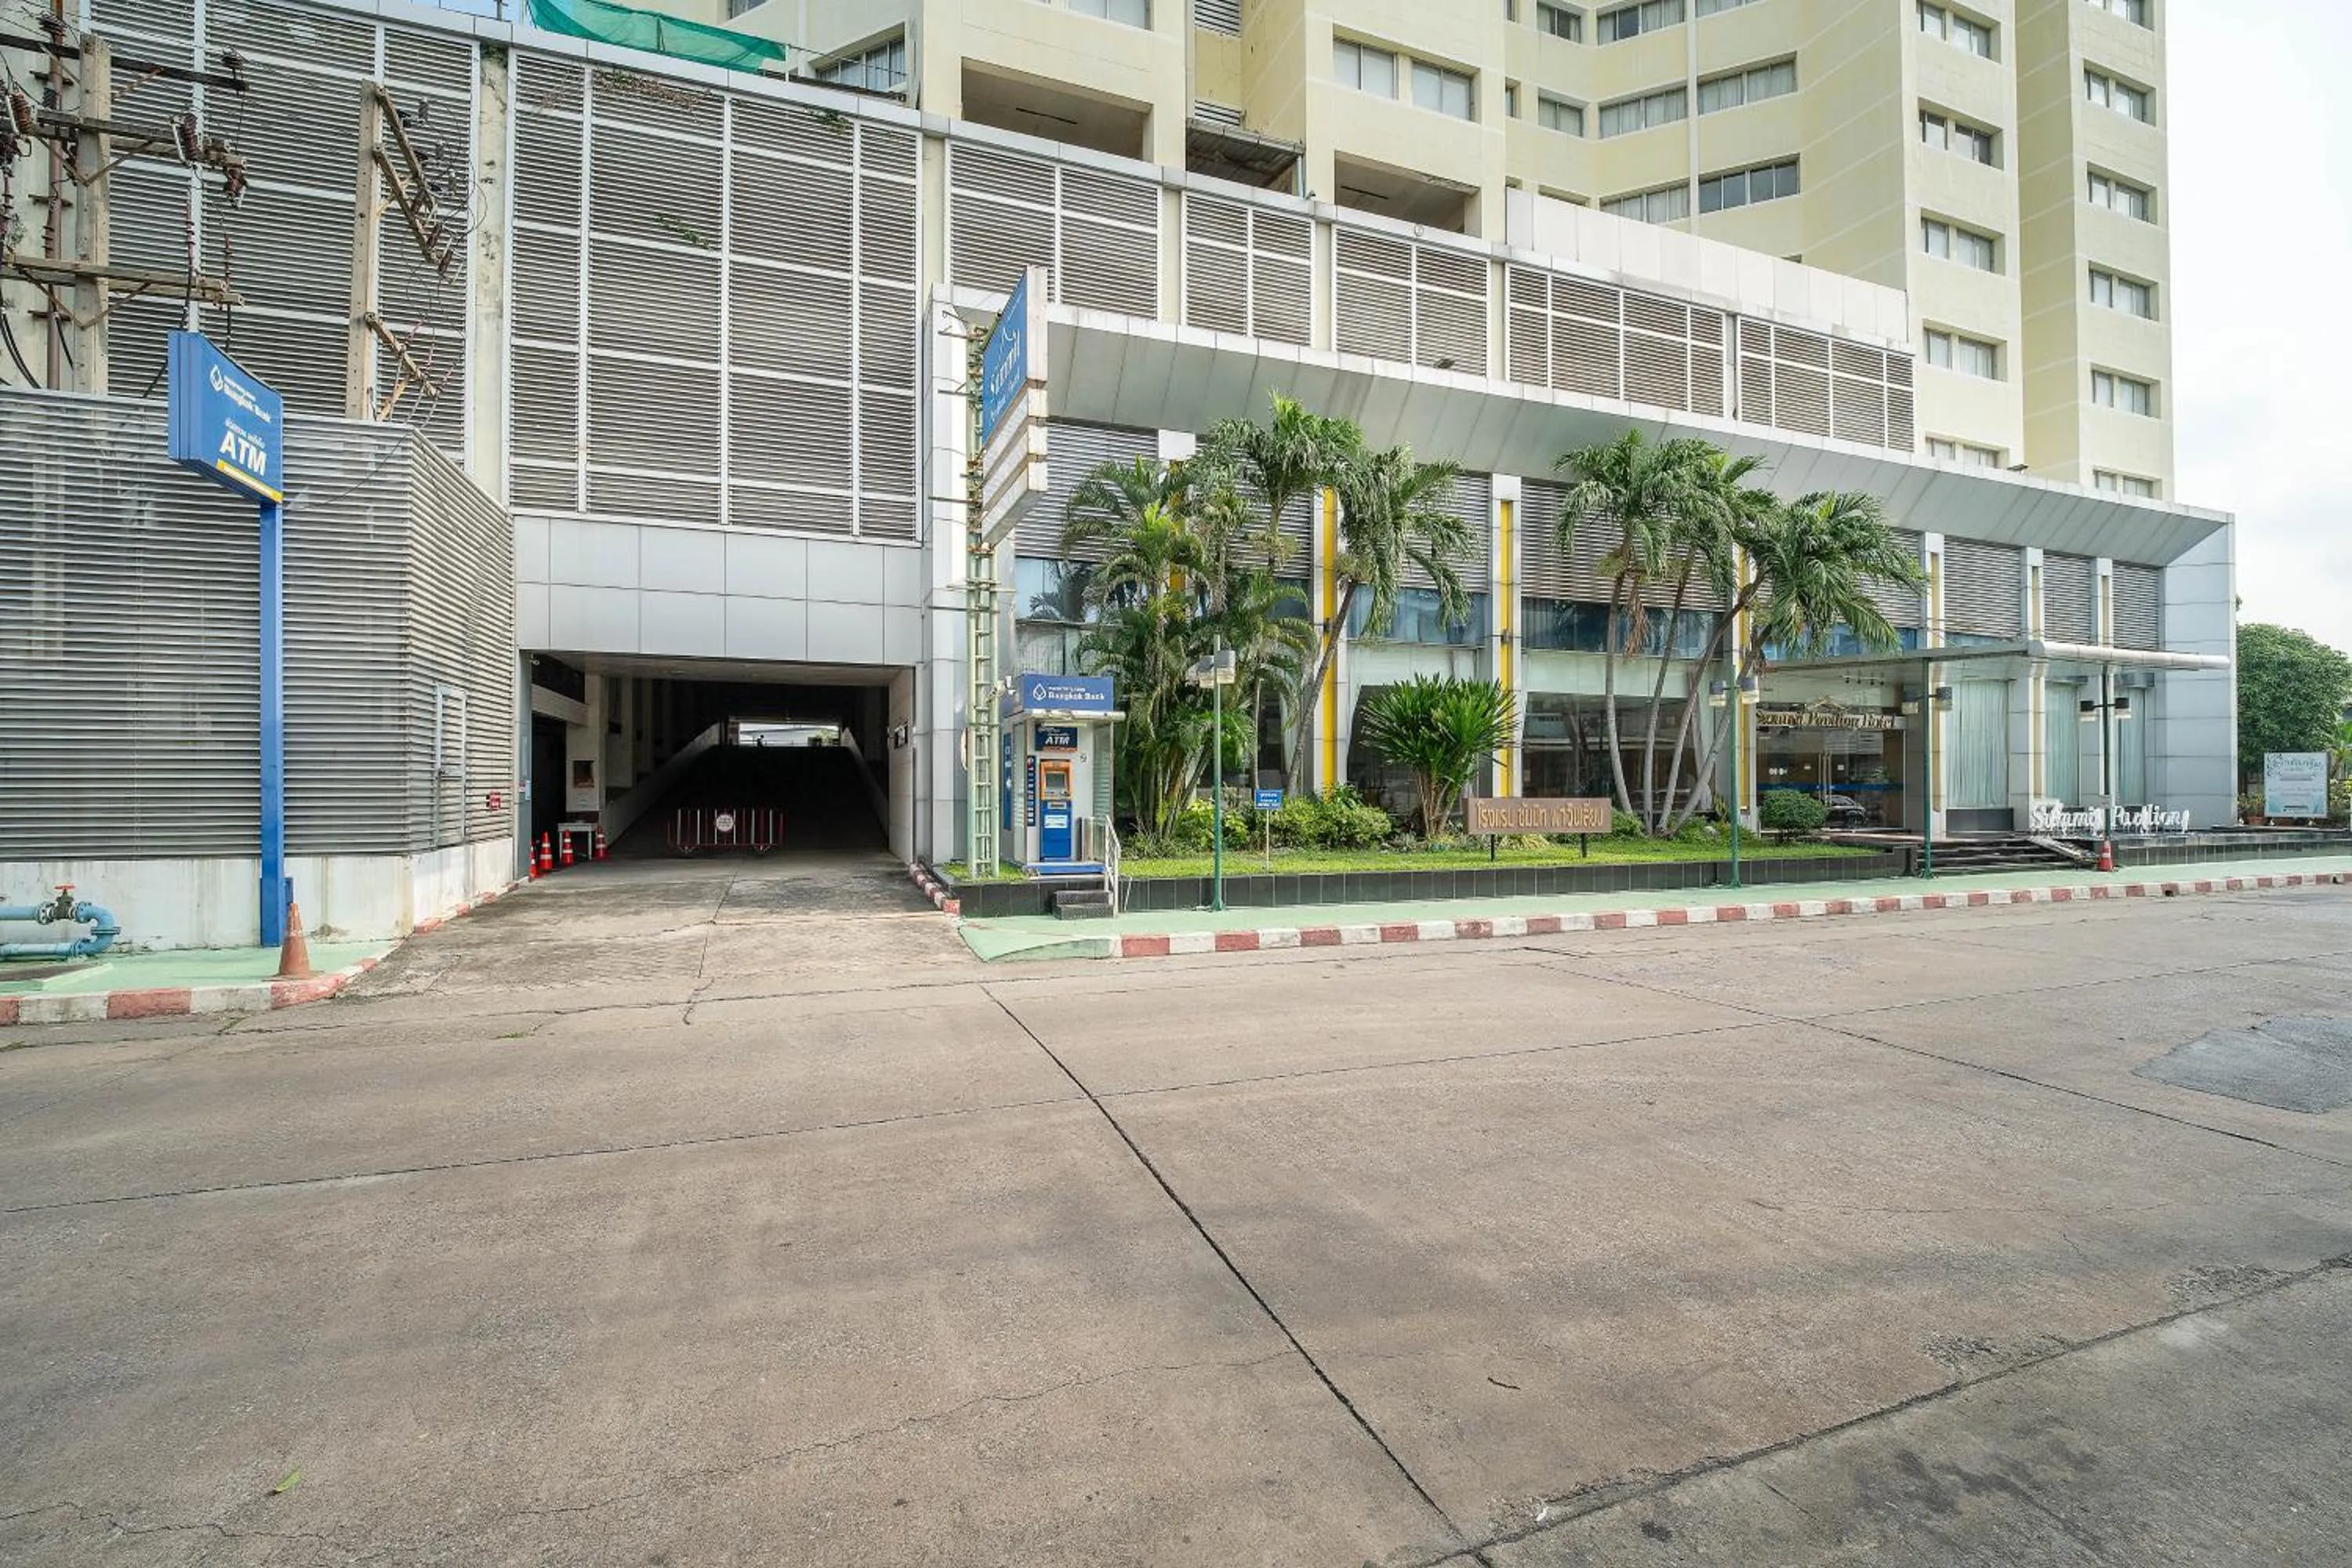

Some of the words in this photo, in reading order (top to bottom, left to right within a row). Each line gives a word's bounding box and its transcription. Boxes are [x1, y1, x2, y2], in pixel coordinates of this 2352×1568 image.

[220, 431, 267, 477] ATM
[1048, 691, 1083, 701] Bangkok
[1045, 736, 1070, 745] ATM
